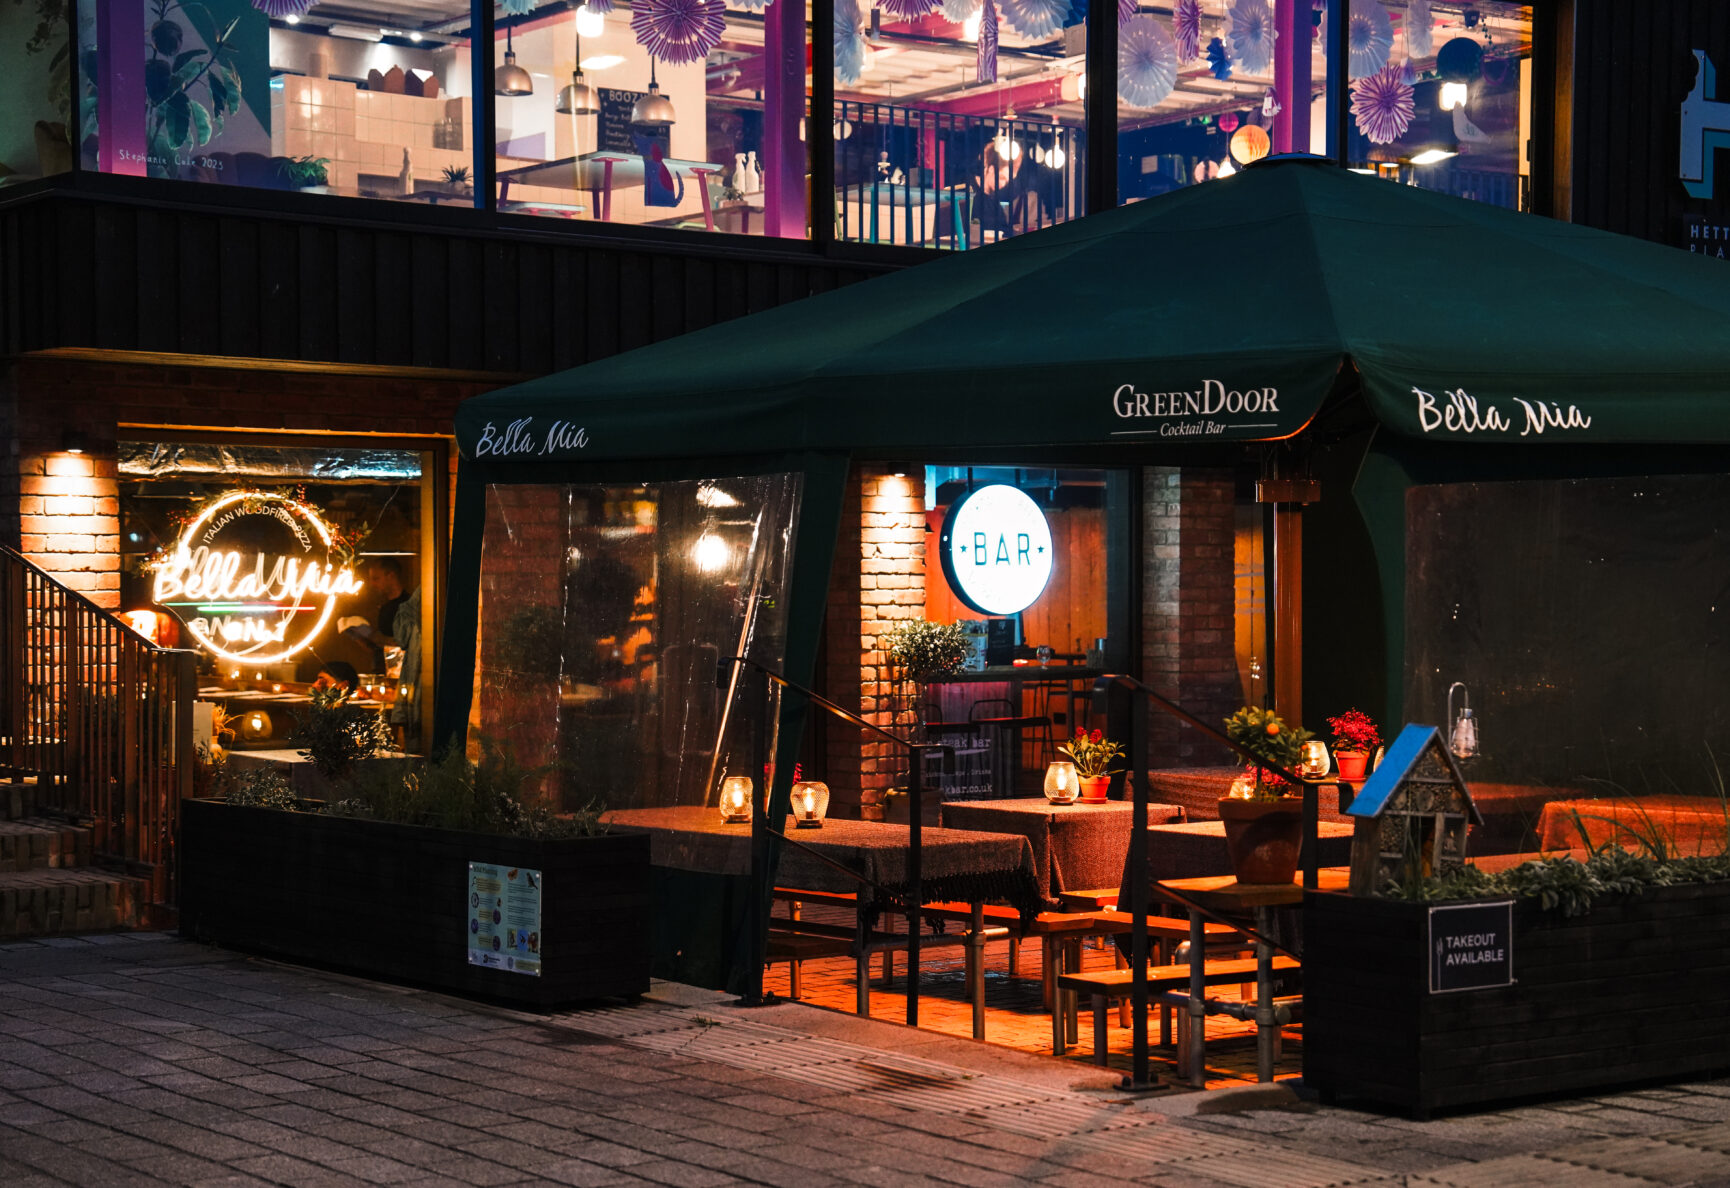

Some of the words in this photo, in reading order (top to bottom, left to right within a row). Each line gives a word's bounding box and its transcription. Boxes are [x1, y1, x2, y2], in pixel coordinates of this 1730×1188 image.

[609, 90, 649, 104] BOOZ
[119, 149, 167, 165] Stephanie
[1411, 386, 1510, 433] Bella
[1513, 397, 1592, 436] Mia
[475, 416, 535, 458] Bella
[538, 420, 589, 456] Mia
[1160, 420, 1203, 437] Cocktail
[1205, 420, 1227, 435] Bar
[203, 511, 235, 545] ITALIAN
[295, 525, 313, 553] PIZZA
[974, 531, 1031, 566] BAR
[153, 551, 267, 602] Bella
[971, 737, 992, 748] bar
[1445, 933, 1496, 949] TAKEOUT
[1445, 949, 1504, 966] AVAILABLE
